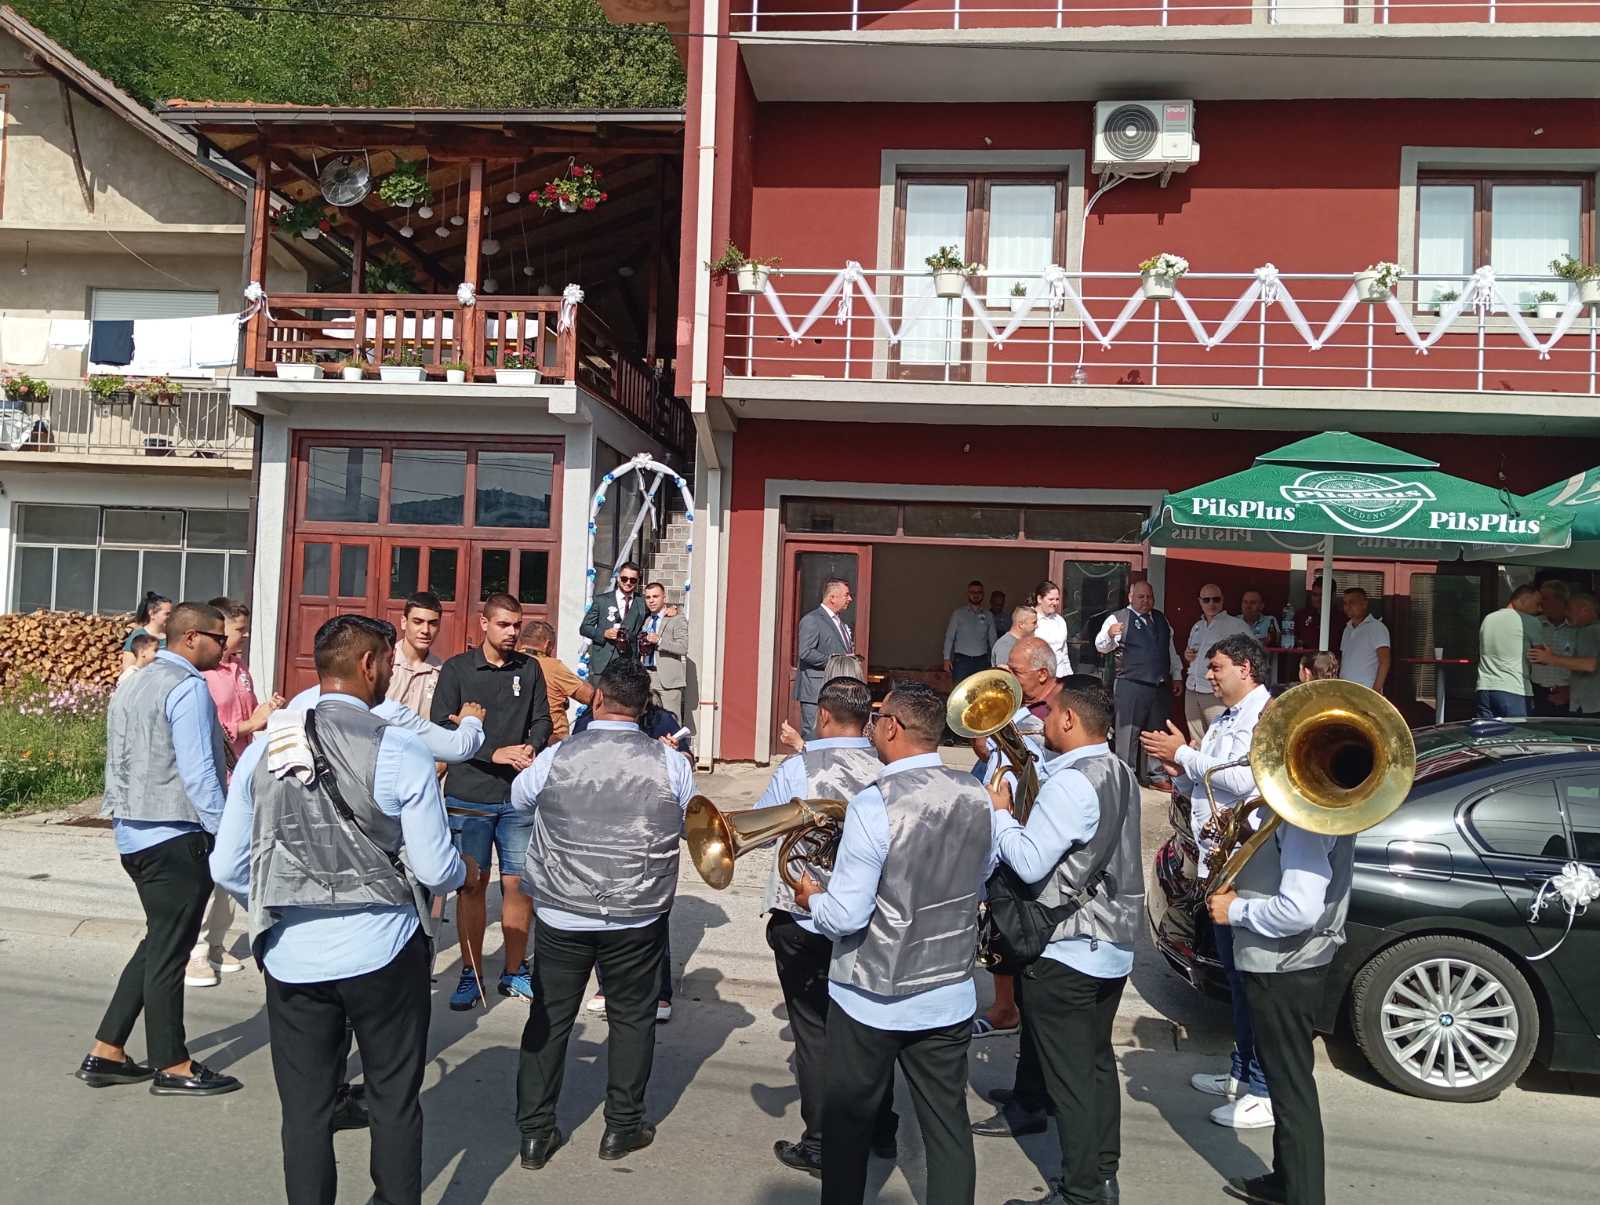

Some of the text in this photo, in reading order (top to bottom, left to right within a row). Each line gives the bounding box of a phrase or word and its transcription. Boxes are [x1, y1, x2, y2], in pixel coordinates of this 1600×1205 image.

[1290, 488, 1423, 499] PilsPlus
[1191, 497, 1296, 521] PilsPlus
[1428, 511, 1541, 534] PilsPlus
